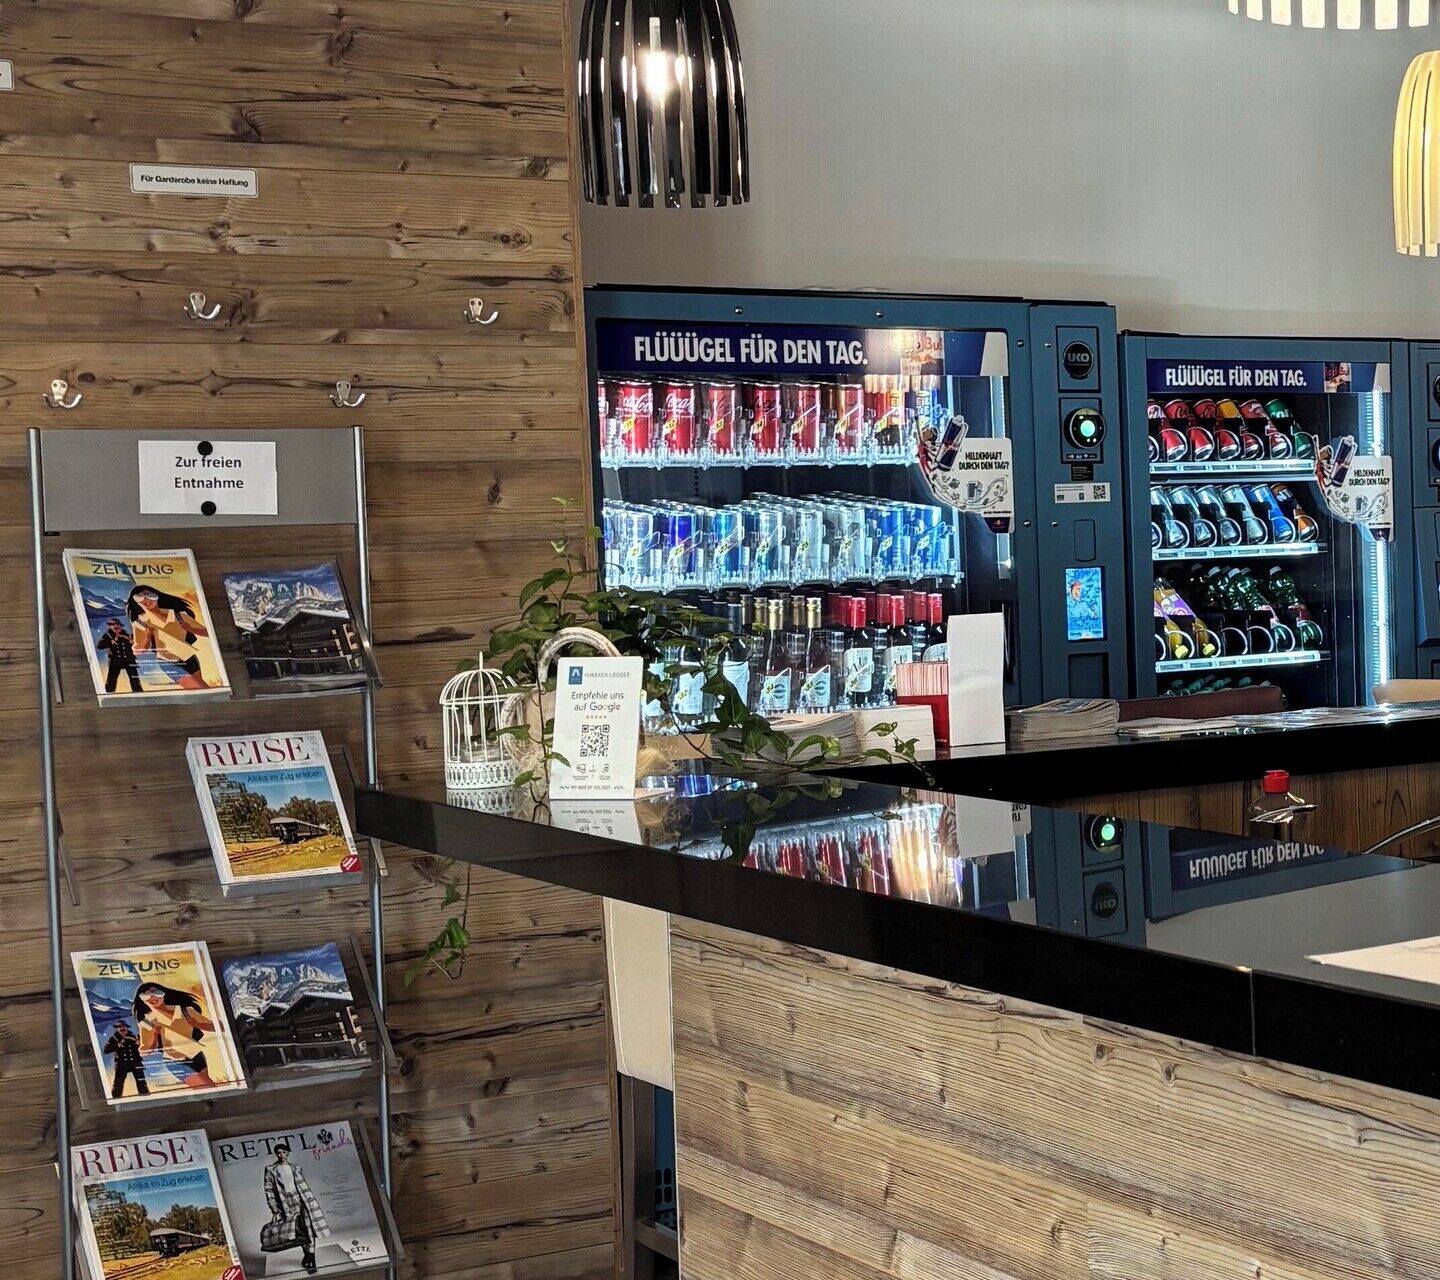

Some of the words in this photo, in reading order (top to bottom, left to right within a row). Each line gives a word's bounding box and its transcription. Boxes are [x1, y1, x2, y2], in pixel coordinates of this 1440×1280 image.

[140, 174, 154, 183] Für
[155, 175, 196, 185] Garderobe
[218, 178, 249, 188] Haftung
[634, 331, 736, 363] FLÜÜÜGEL
[740, 333, 778, 364] FÜR
[783, 339, 823, 365] DEN
[826, 340, 869, 366] TAG.
[1165, 364, 1227, 387] FLÜÜÜGEL
[1229, 365, 1252, 387] FÜR
[1255, 369, 1279, 387] DEN
[1280, 369, 1308, 387] TAG.
[175, 456, 197, 468] Zur
[202, 455, 242, 468] freien
[965, 451, 1003, 461] HELDENHAFT
[959, 461, 980, 471] DURCH
[980, 462, 994, 470] DEN
[174, 477, 244, 489] Entnahme
[91, 562, 174, 576] ZEITUNG
[571, 691, 609, 701] Empfehle
[610, 692, 625, 700] uns
[574, 703, 587, 711] auf
[589, 702, 621, 713] Google
[200, 736, 311, 767] REISE
[97, 958, 180, 977] ZEITUNG
[218, 1132, 317, 1163] RETTL
[79, 1136, 194, 1177] REISE
